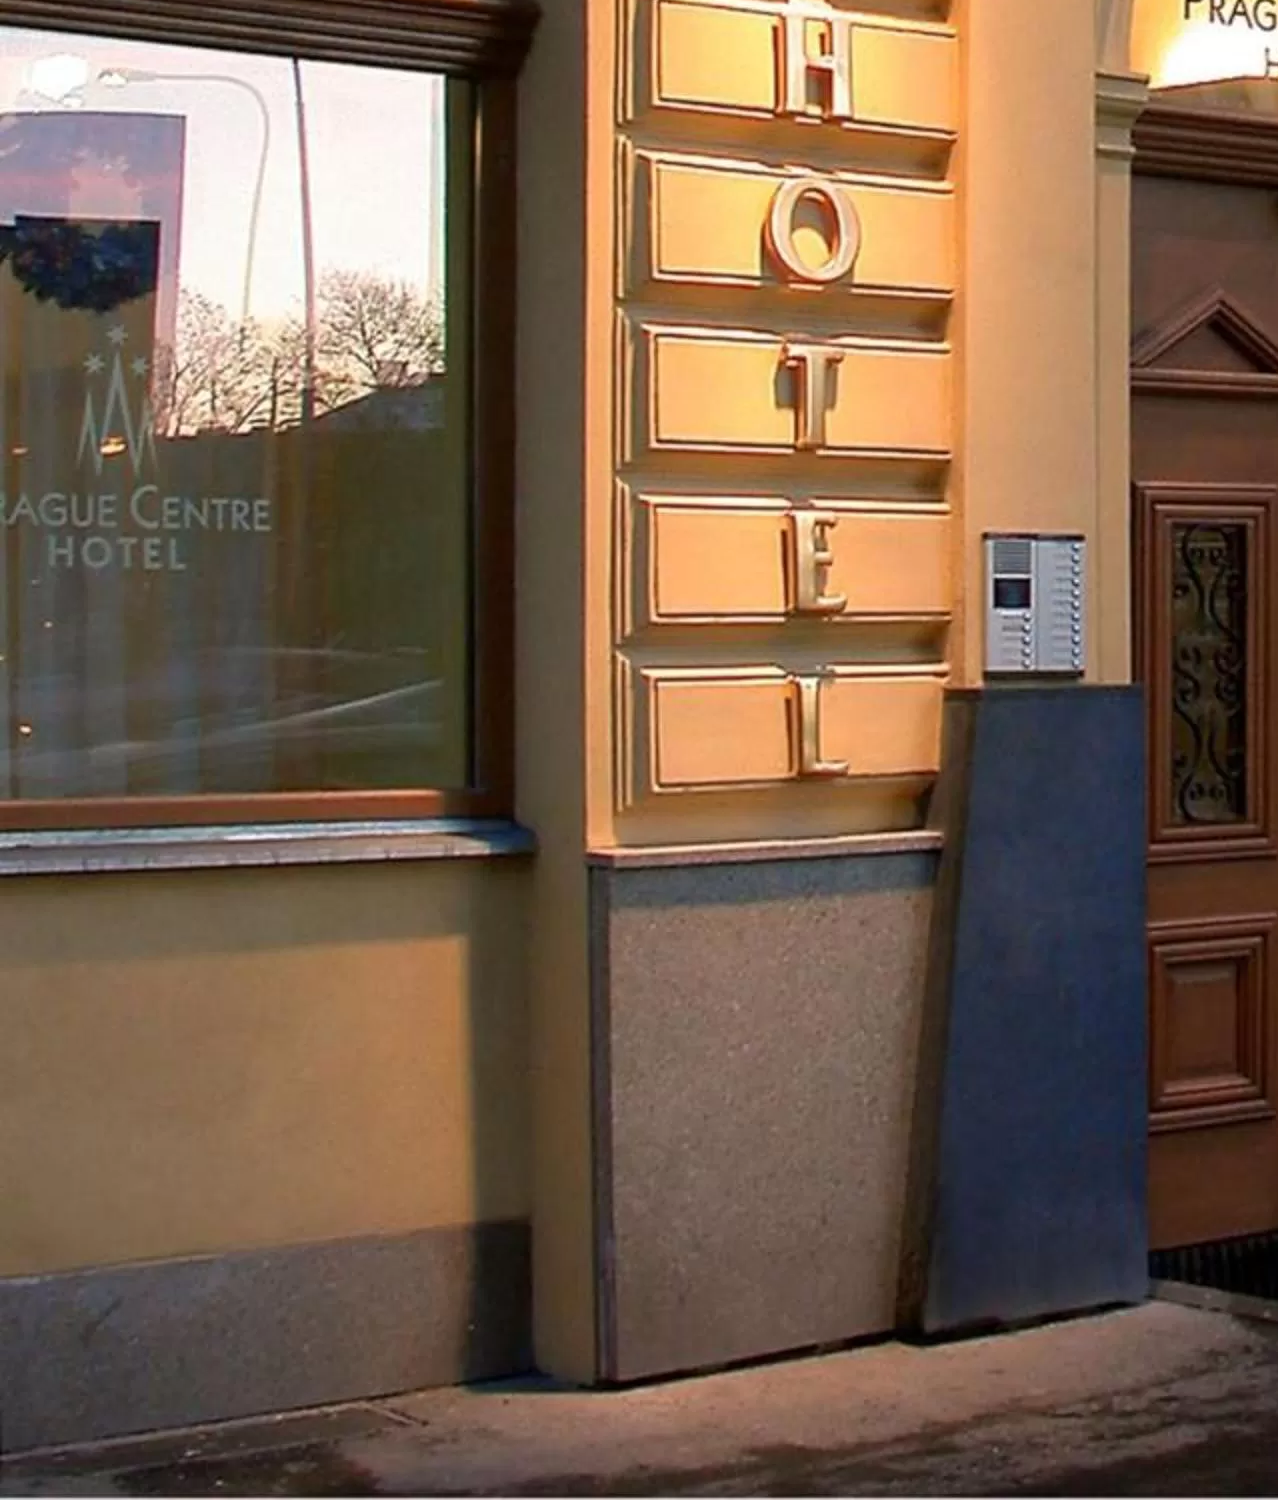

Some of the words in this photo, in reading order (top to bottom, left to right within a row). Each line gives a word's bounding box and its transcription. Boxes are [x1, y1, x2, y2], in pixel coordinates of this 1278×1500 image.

[764, 4, 861, 778] HOTEL
[130, 484, 273, 532] CENTRE
[47, 535, 187, 570] HOTEL
